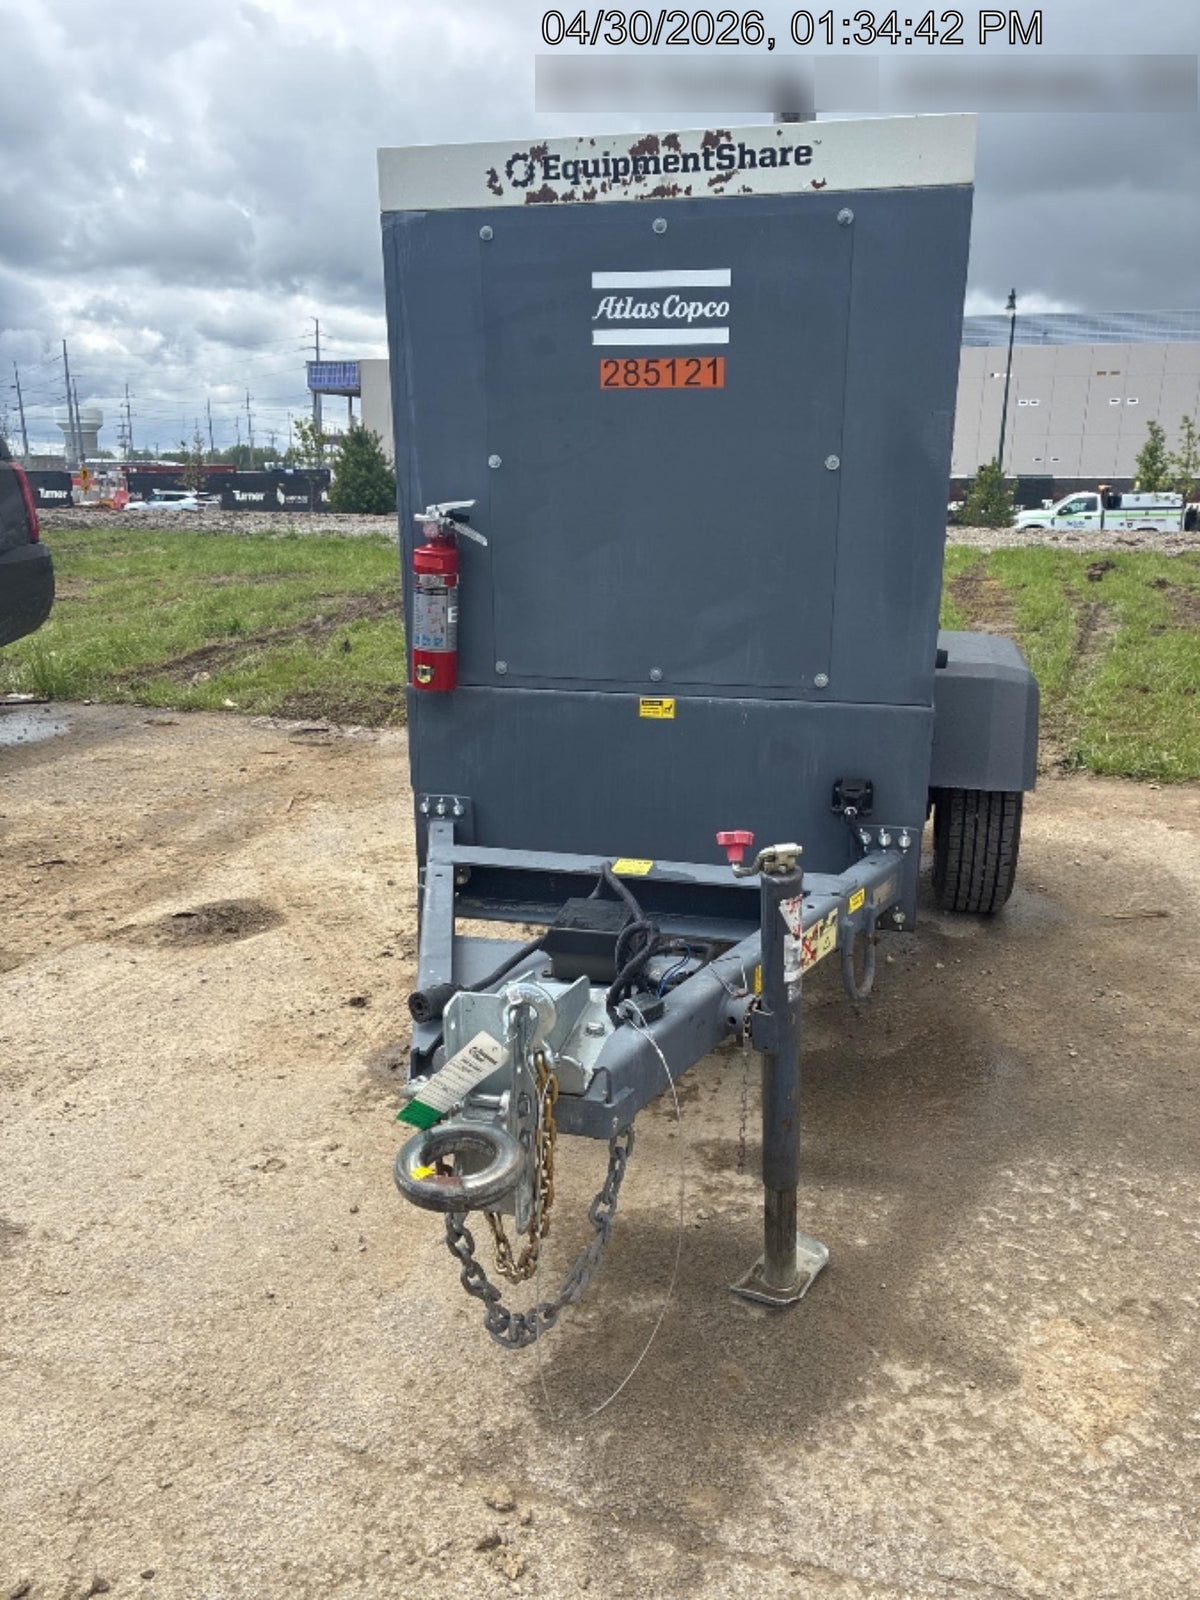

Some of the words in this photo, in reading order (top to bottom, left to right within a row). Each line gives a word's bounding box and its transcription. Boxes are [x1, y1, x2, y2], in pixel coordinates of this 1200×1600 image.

[541, 142, 814, 184] EquipmentShare
[592, 296, 660, 320] Atlas
[662, 294, 730, 323] Copco
[603, 356, 718, 387] 285121
